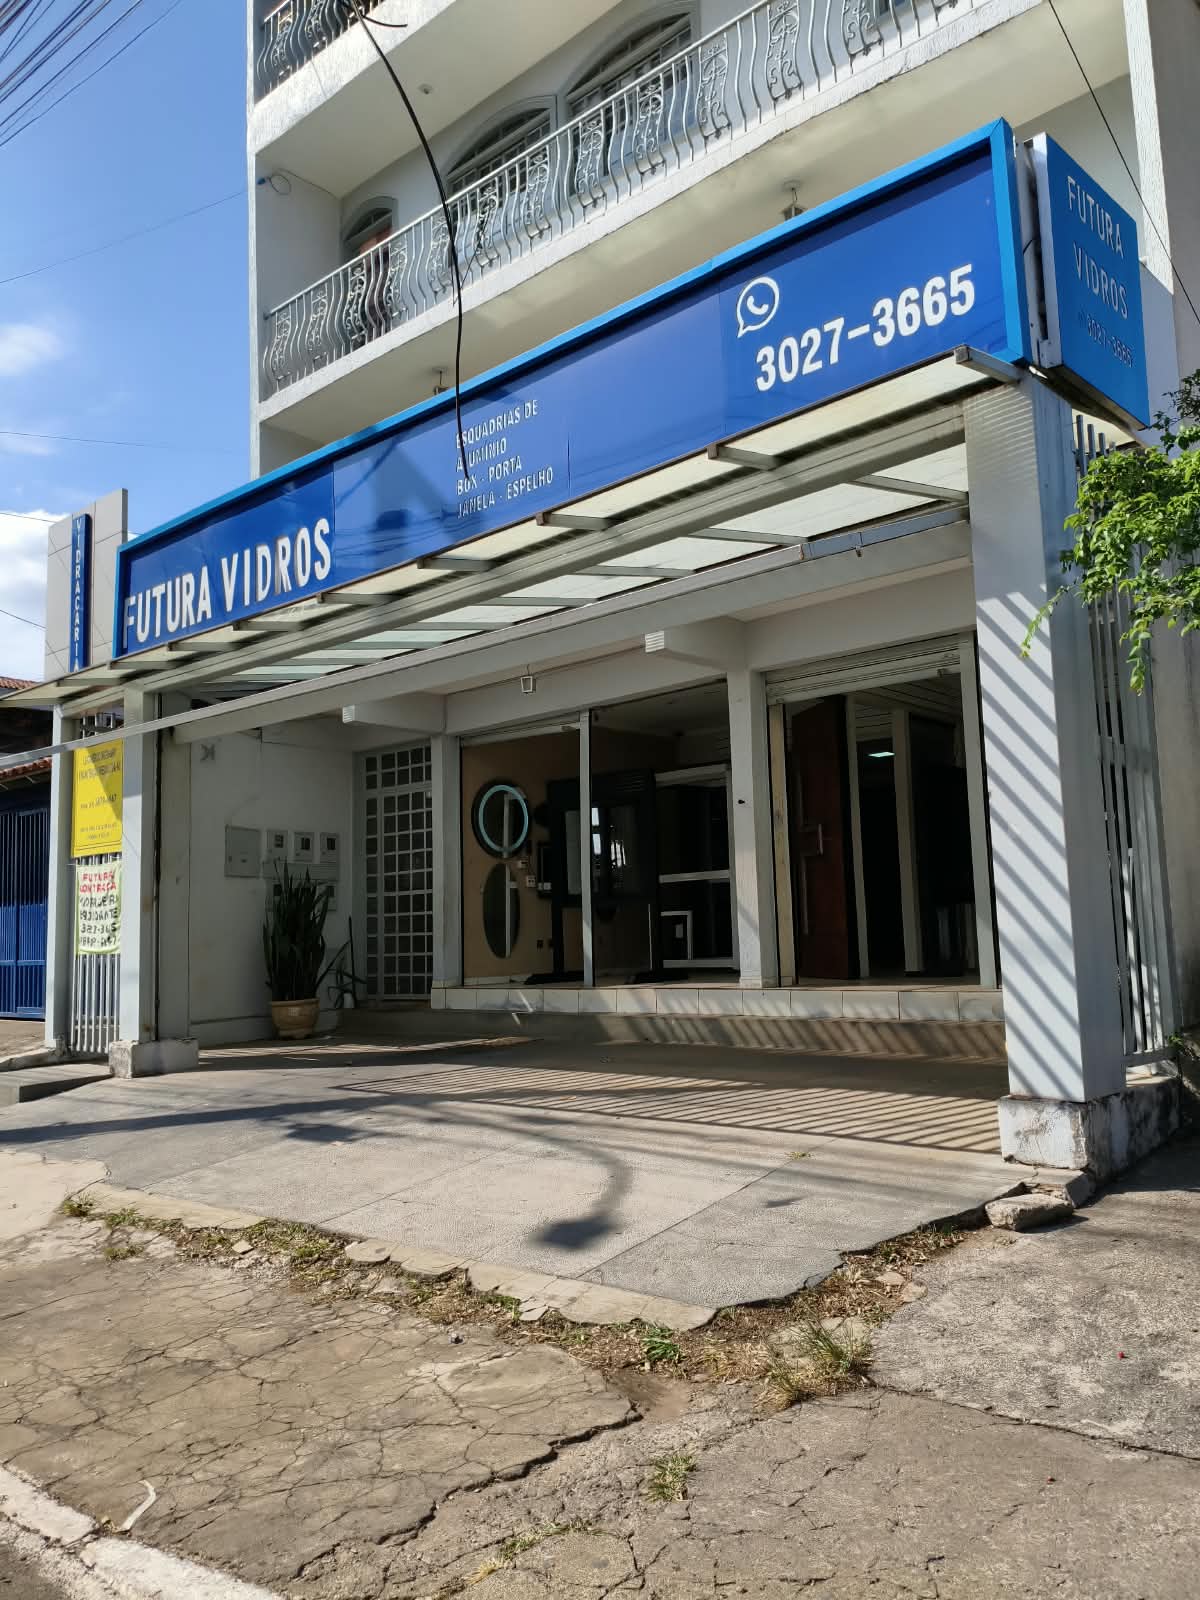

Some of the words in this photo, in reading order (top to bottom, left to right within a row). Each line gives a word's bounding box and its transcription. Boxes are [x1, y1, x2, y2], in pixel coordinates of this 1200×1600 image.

[1067, 174, 1124, 260] FUTURA
[1072, 240, 1129, 321] VIDROS
[755, 263, 976, 393] 3027-3665
[456, 407, 521, 448] ESQUADRIAS
[525, 399, 538, 419] DE
[456, 437, 507, 473] AUMÍNIO
[457, 473, 478, 496] BOX
[488, 455, 522, 484] PORTA
[457, 491, 495, 519] JANELA
[506, 466, 554, 501] ESPELHO
[73, 518, 81, 672] VIDRACARIA
[123, 566, 212, 649] FUTURA
[220, 517, 332, 613] VIDROS
